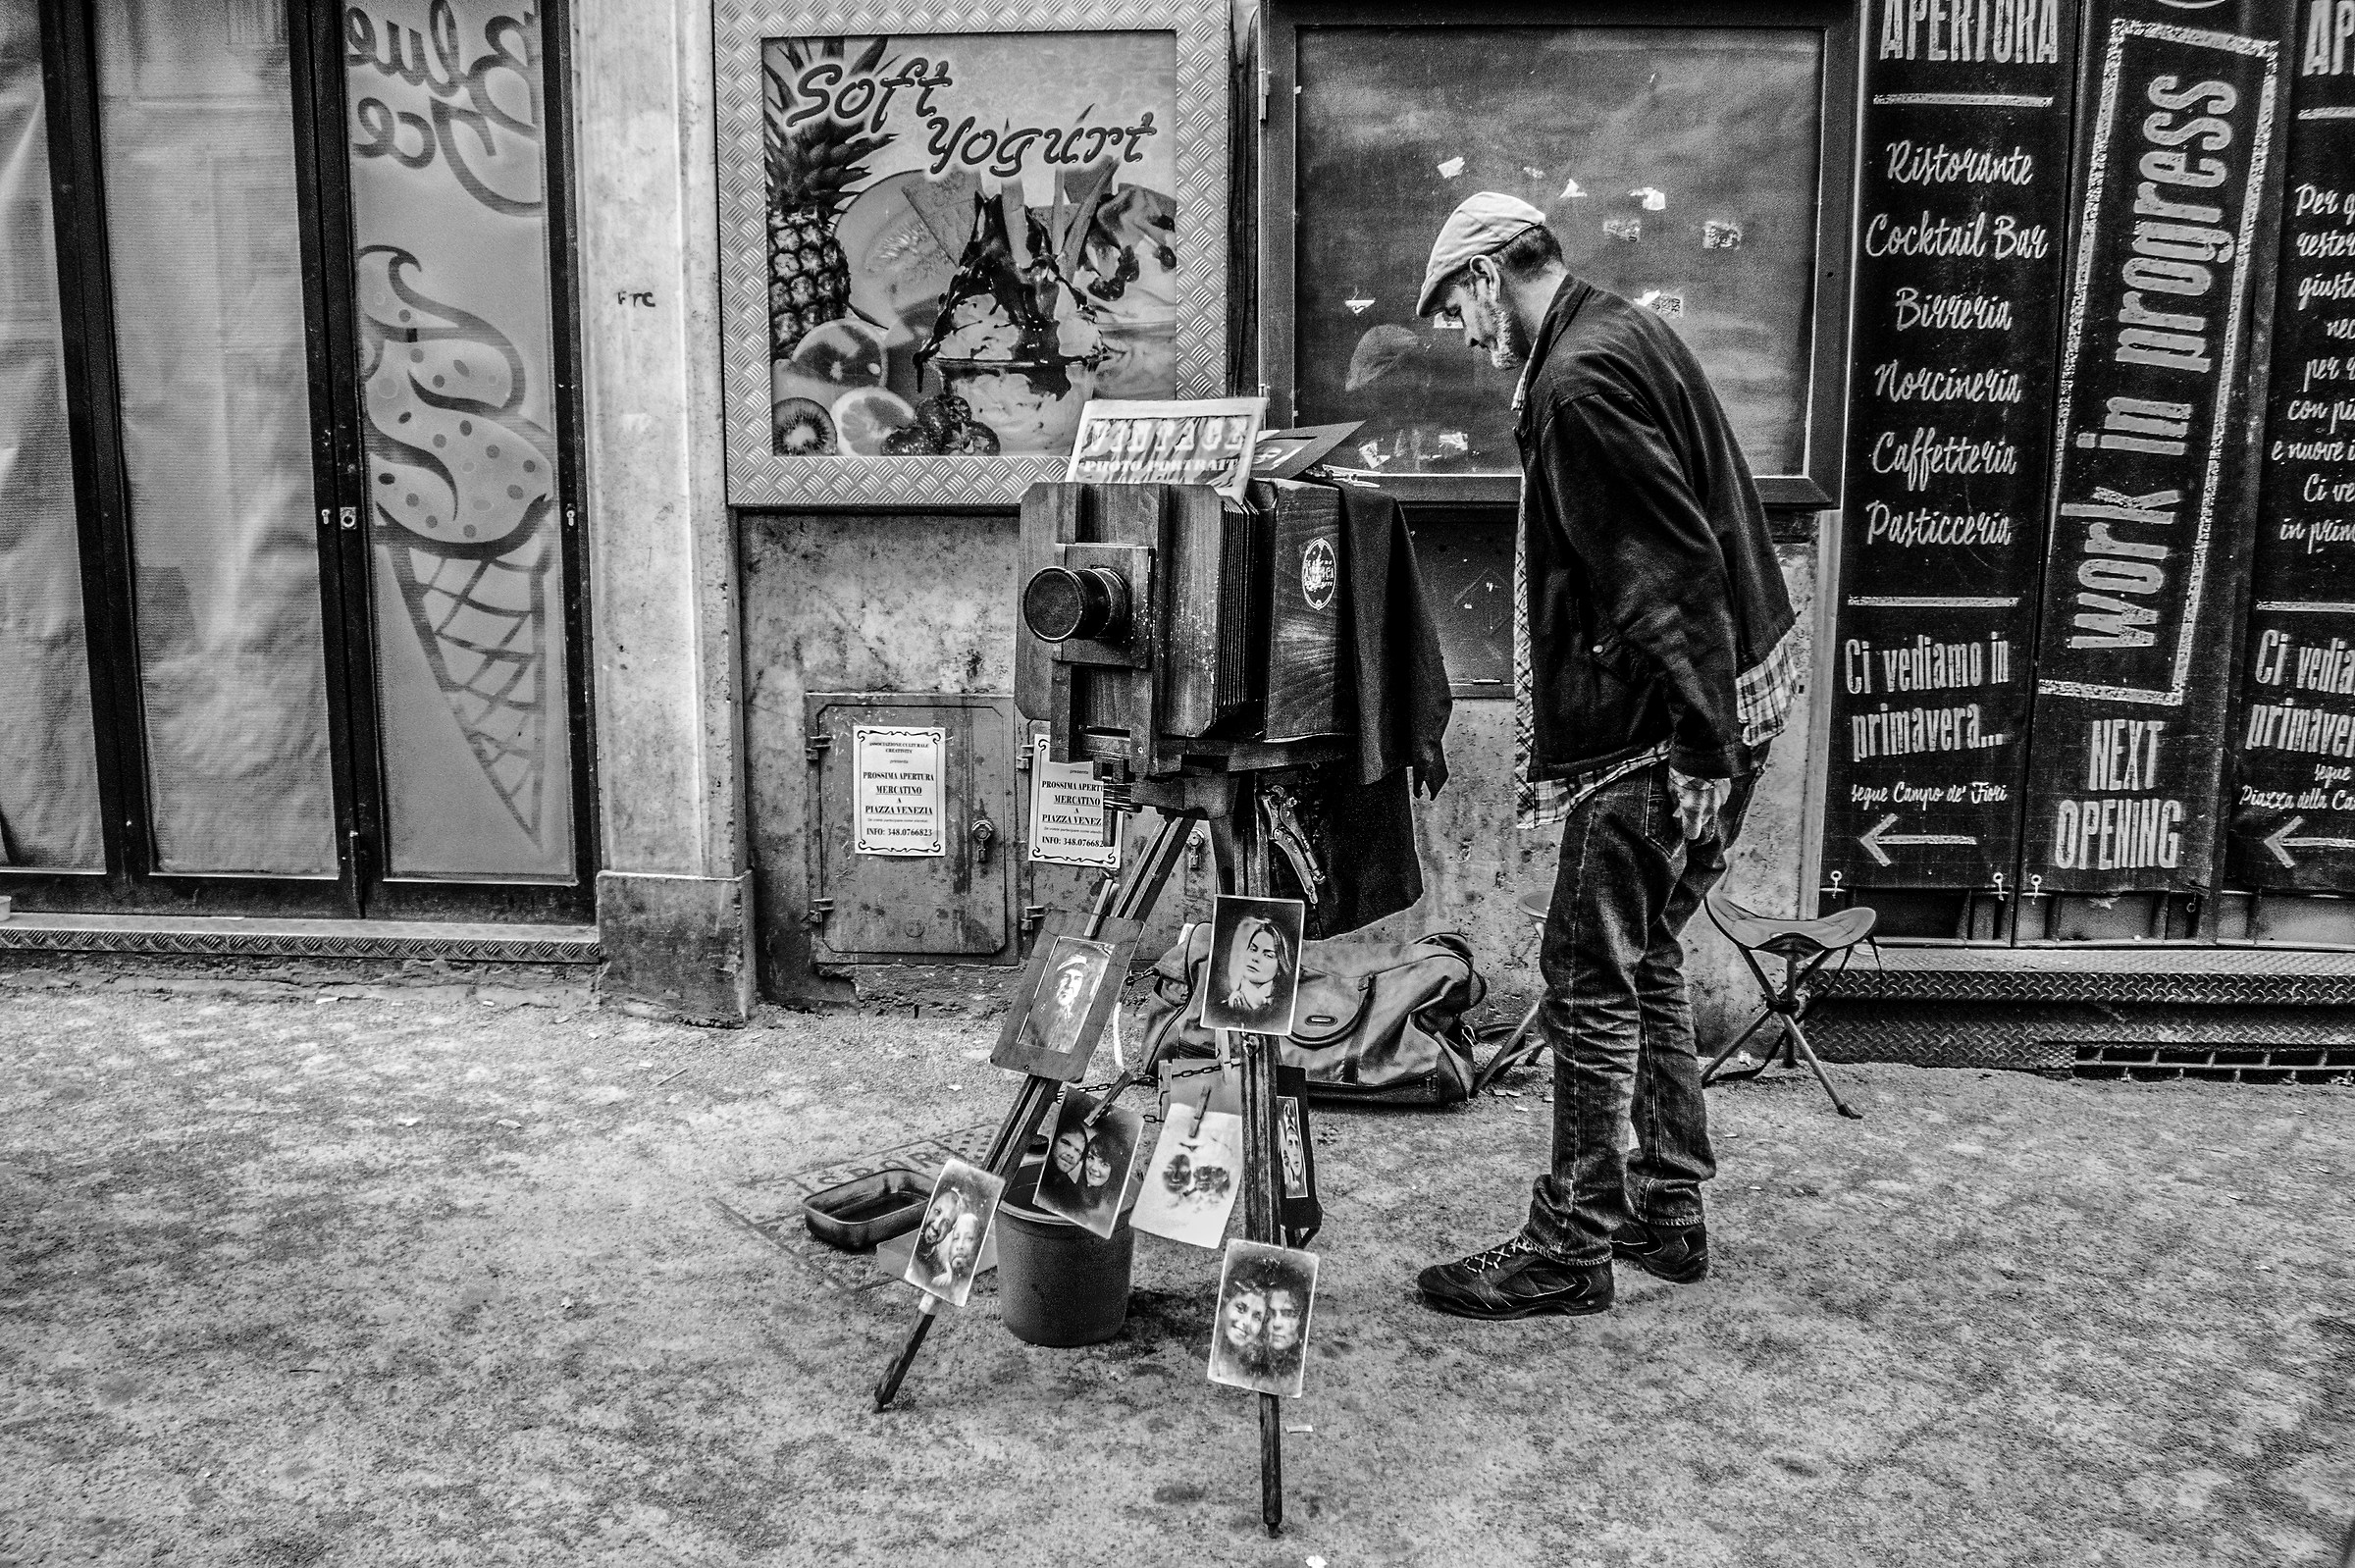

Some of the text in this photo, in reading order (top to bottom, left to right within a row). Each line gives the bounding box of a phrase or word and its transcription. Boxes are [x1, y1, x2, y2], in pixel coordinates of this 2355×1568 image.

[1879, 0, 2058, 64] APERTURA
[2302, 0, 2355, 76] AP
[787, 57, 953, 133] Soft
[926, 111, 1157, 178] Yogurt
[1886, 139, 2033, 185] Ristorante
[2295, 183, 2338, 216] Per
[1865, 210, 2049, 260] Cocktail Bar
[1895, 287, 2013, 332] Birreria
[2061, 76, 2238, 649] work in progress
[2303, 356, 2339, 392] per
[1874, 359, 2022, 403] Norcineria
[2287, 400, 2328, 420] con
[1089, 416, 1249, 451] VINTAGE
[2272, 441, 2284, 461] e
[2287, 441, 2344, 461] nuove
[1149, 456, 1240, 472] PORTRAIT
[1872, 427, 2017, 492] Caffetteria
[2303, 473, 2329, 502] Ci
[1865, 499, 2012, 548] Pasticceria
[2279, 518, 2306, 541] in
[1845, 631, 2009, 695] Ci vediamo in
[2255, 629, 2289, 686] Ci
[1852, 703, 2004, 762] primavera...
[2089, 719, 2165, 791] NEXT
[863, 771, 934, 781] PROSSIMA APERTURA
[875, 785, 922, 796] MERCATINO
[1041, 780, 1076, 790] PROSSIMA
[2314, 763, 2351, 789] segue
[864, 806, 933, 815] PIAZZA VENEZIA
[1054, 795, 1101, 807] MERCATINO
[1851, 783, 1889, 811] segue
[1893, 781, 1944, 811] Campo
[1970, 781, 2008, 805] Fiori
[2239, 784, 2355, 810] Piazza della Ca
[1041, 814, 1072, 824] PIAZZA
[2055, 799, 2182, 870] OPENING
[1042, 835, 1061, 845] INFO:
